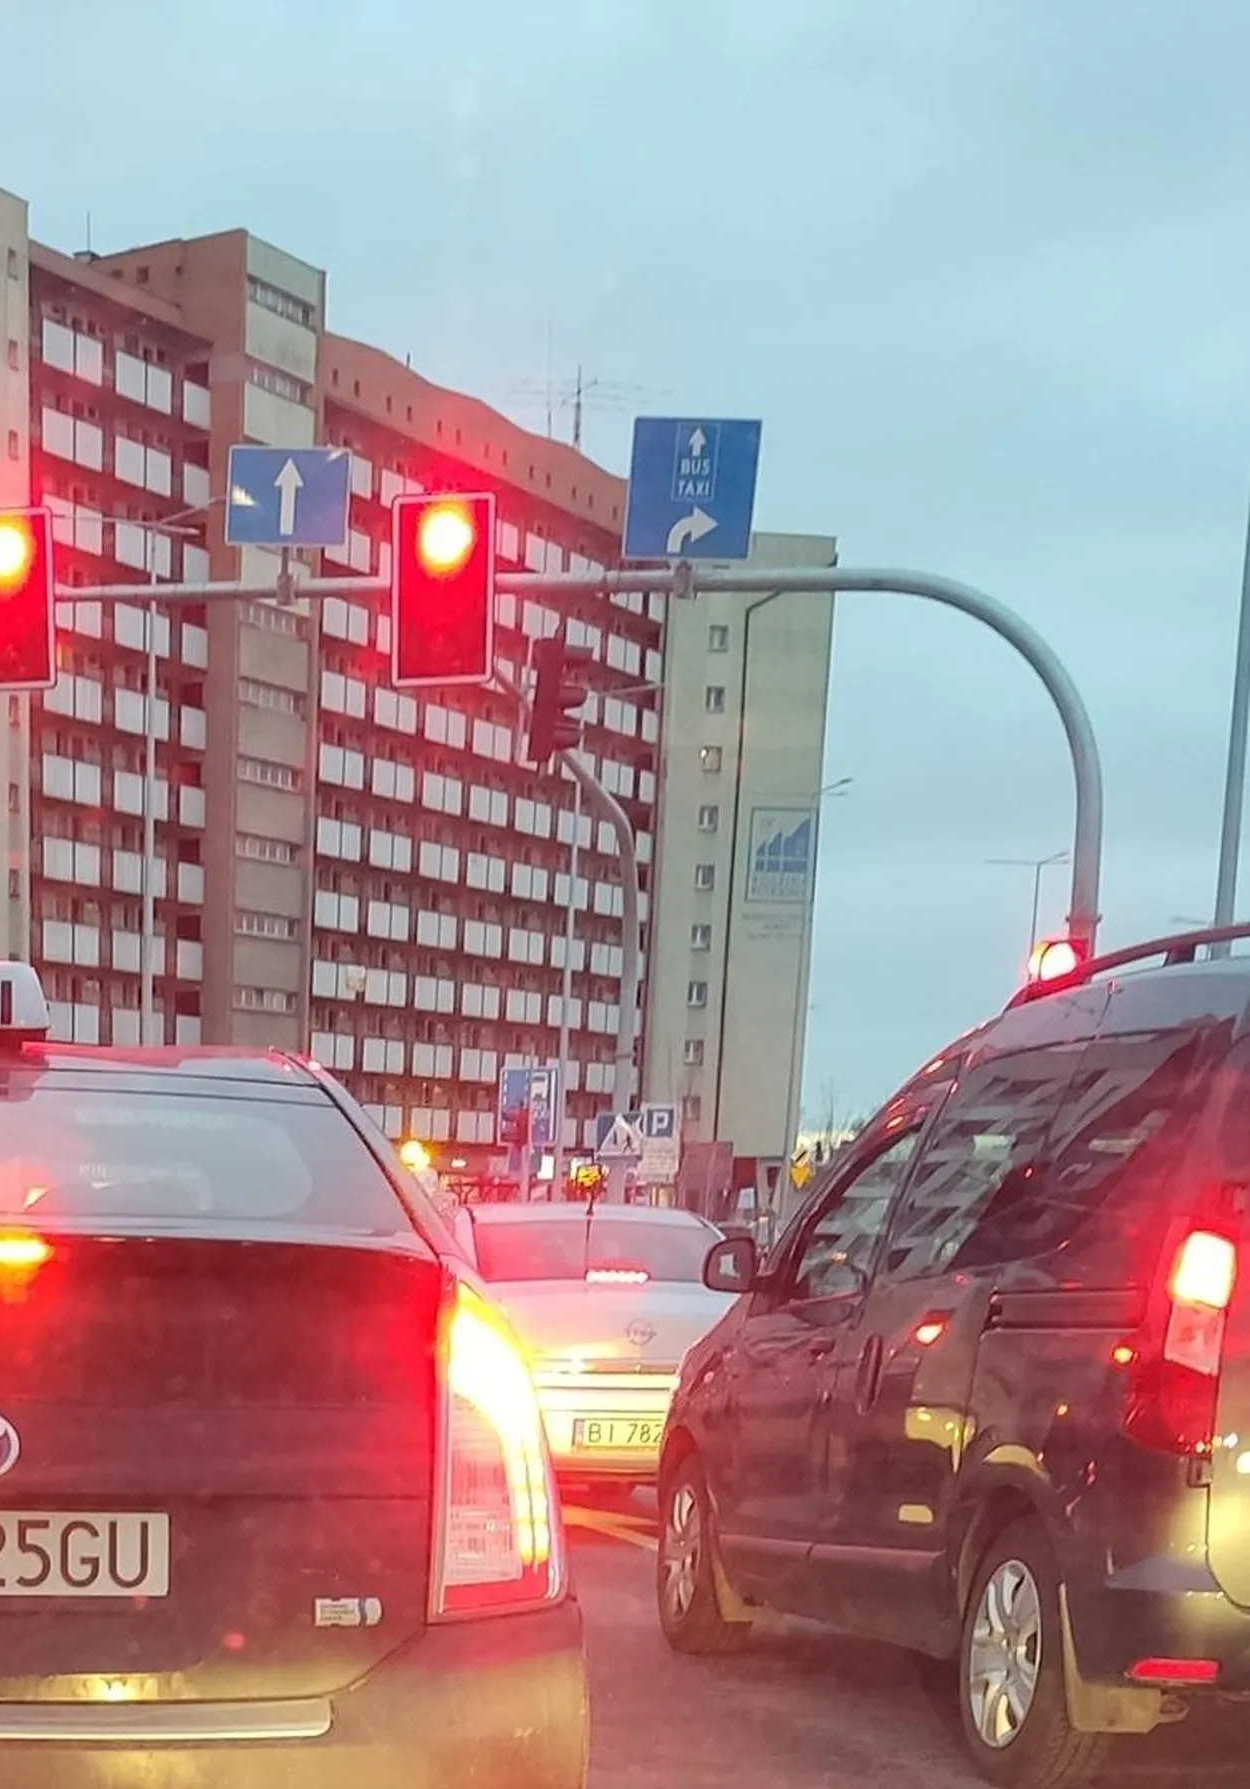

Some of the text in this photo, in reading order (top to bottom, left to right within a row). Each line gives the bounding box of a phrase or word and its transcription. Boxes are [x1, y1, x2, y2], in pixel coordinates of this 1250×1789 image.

[681, 458, 711, 476] BUS
[678, 479, 710, 497] TAXI
[652, 1112, 669, 1136] P
[588, 1423, 614, 1443] BI
